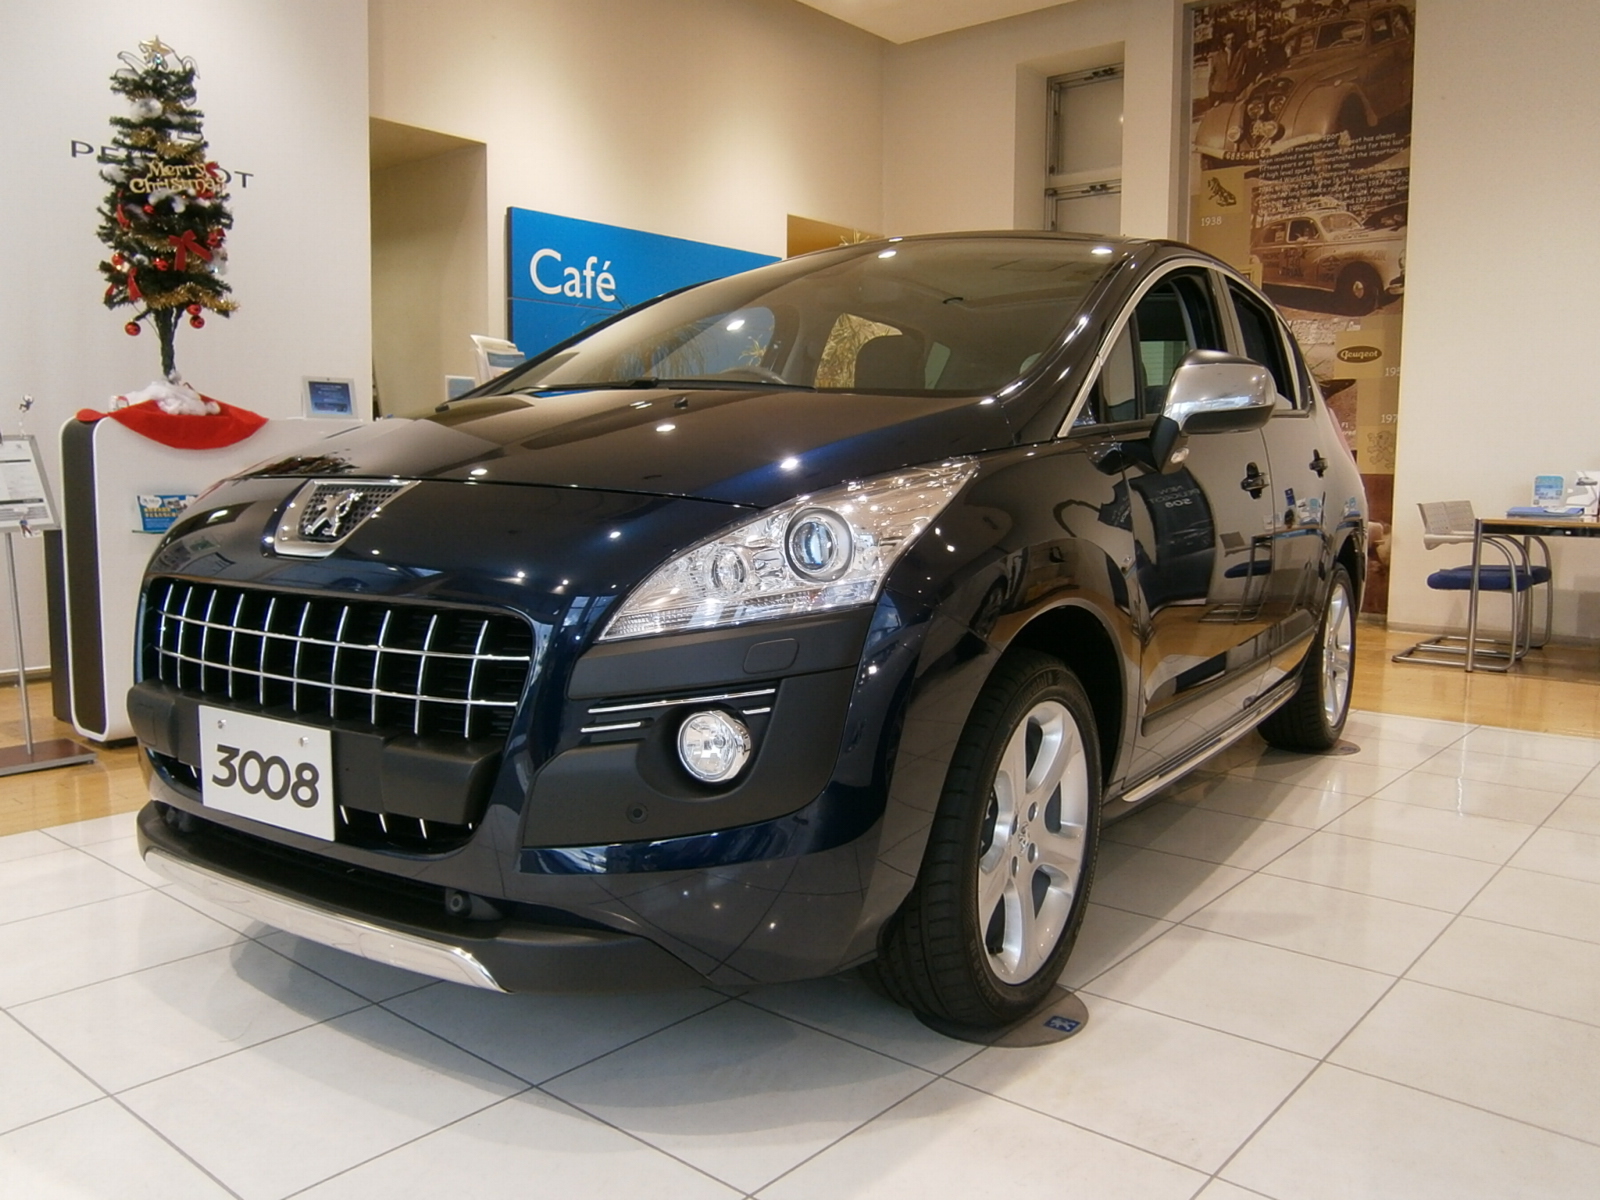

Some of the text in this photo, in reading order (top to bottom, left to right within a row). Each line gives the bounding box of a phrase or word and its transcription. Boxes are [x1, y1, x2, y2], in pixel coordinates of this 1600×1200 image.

[1201, 216, 1222, 226] 1938
[530, 248, 616, 302] Café
[212, 744, 319, 808] 3008
